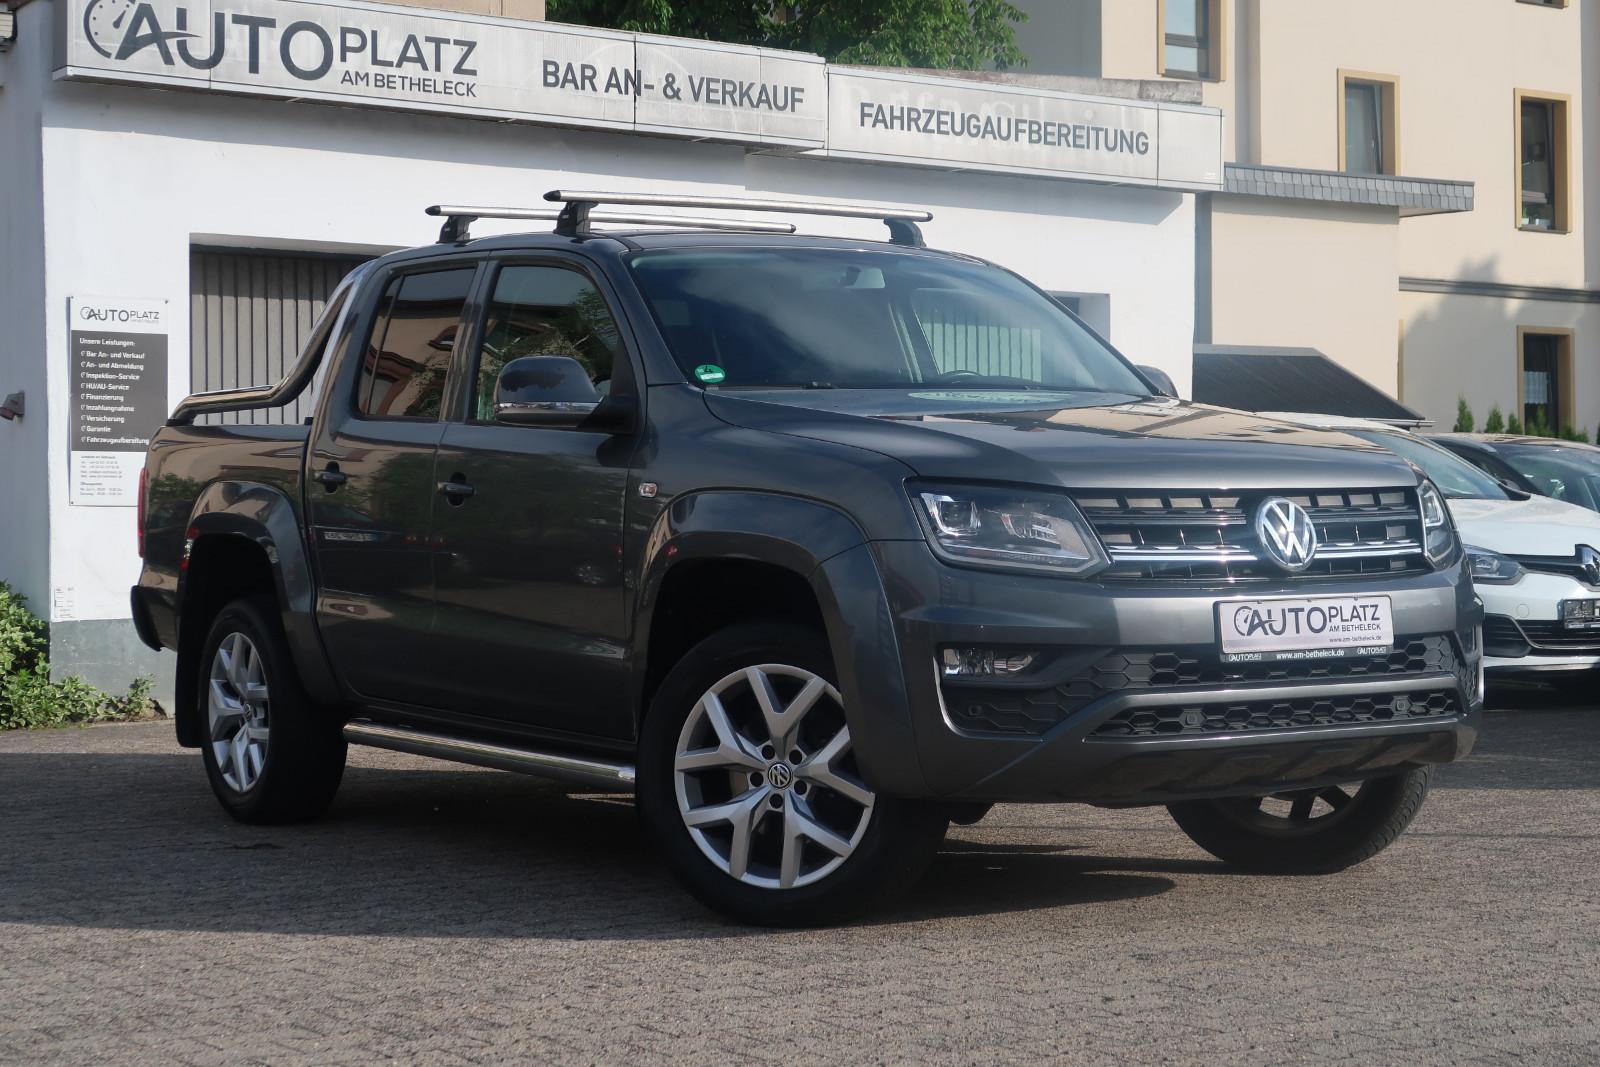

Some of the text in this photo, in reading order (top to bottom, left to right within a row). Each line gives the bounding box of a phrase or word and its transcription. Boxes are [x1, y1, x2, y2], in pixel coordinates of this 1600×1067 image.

[341, 70, 477, 97] AM BETHELECK
[543, 60, 804, 112] BAR AN- & VERKAUF
[860, 102, 1149, 155] FAHRZEUGAUFBEREITUNG
[80, 337, 101, 345] Unsere
[110, 362, 144, 371] Abmeldung
[86, 393, 124, 402] Finanzierung
[86, 415, 125, 424] Versicherung
[86, 425, 112, 433] Garantie
[1342, 623, 1382, 632] BETHELECK
[1276, 649, 1345, 660] www.am-betheleck.de
